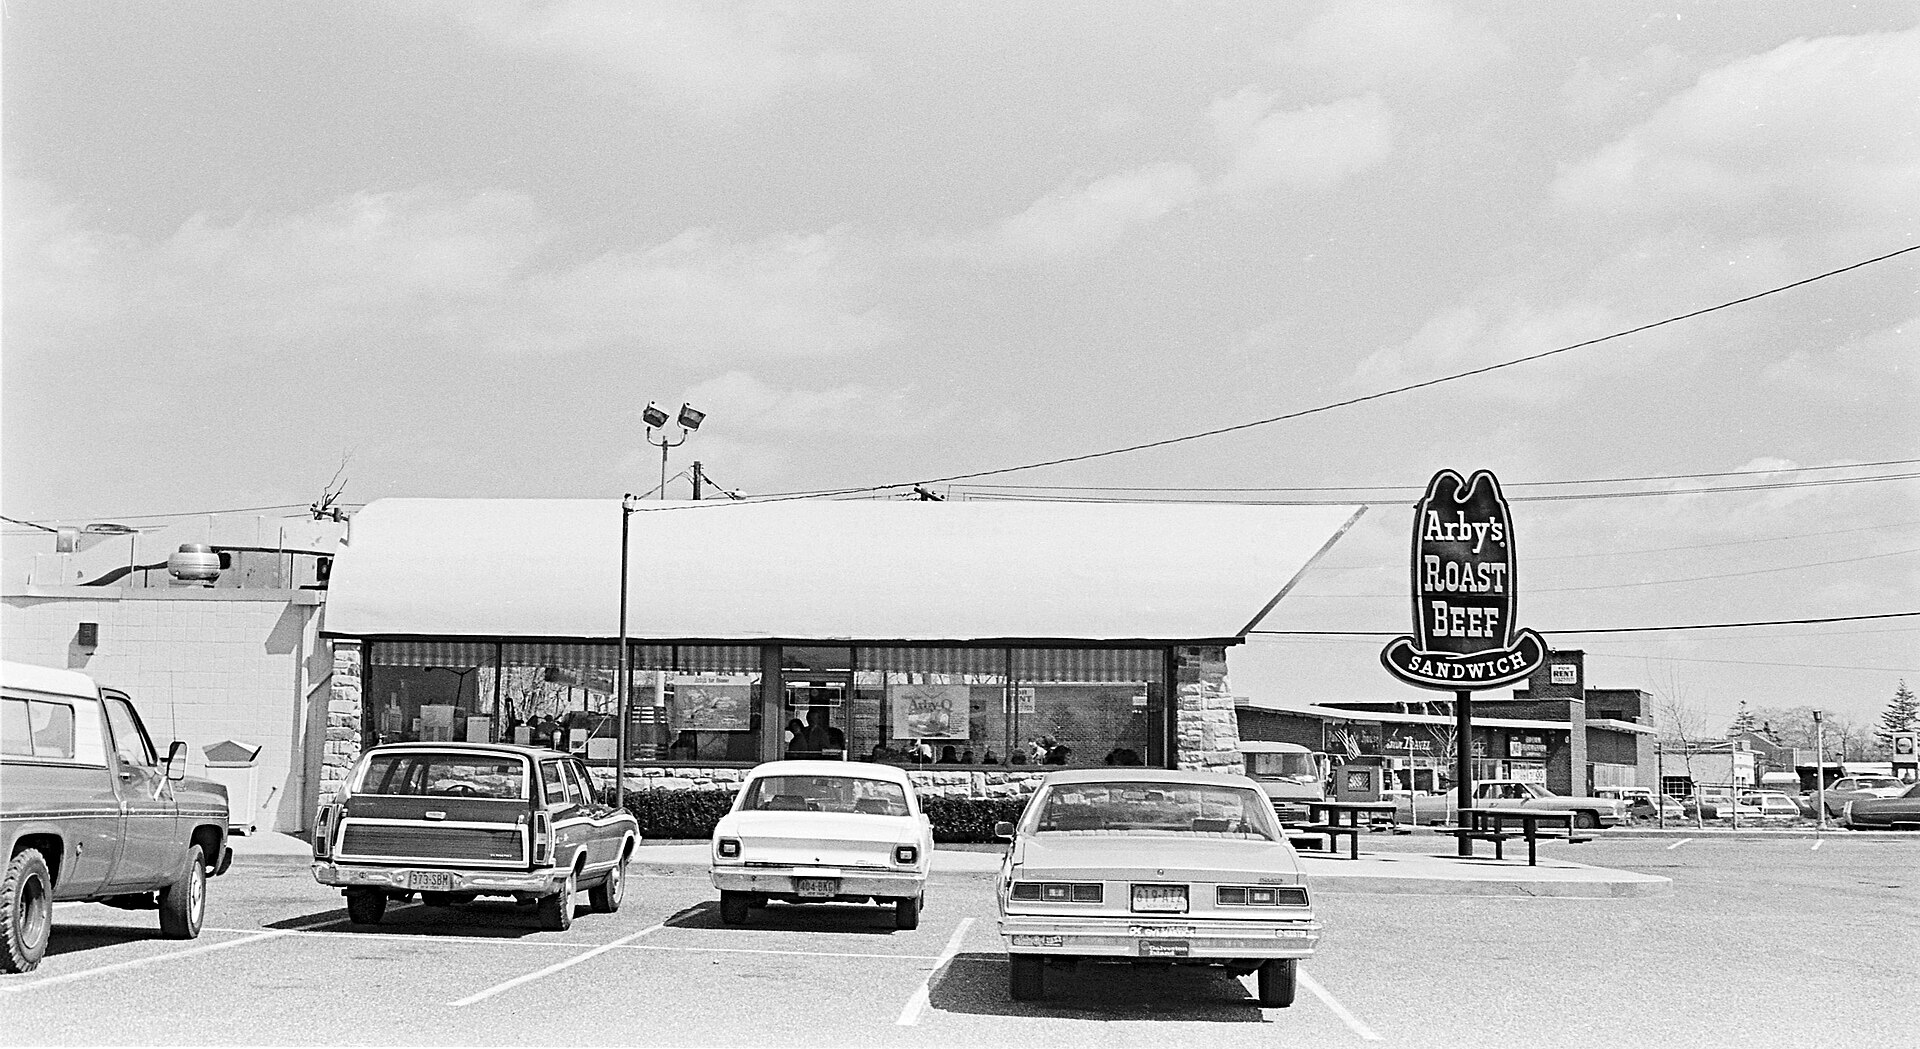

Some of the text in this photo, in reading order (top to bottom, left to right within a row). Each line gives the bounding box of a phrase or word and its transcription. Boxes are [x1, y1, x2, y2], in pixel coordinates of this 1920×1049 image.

[1424, 510, 1503, 553] Arby's
[1424, 554, 1506, 593] ROAST
[1432, 600, 1499, 638] BEEF
[1408, 652, 1527, 679] SANDWICH
[412, 873, 449, 886] 373-SBM
